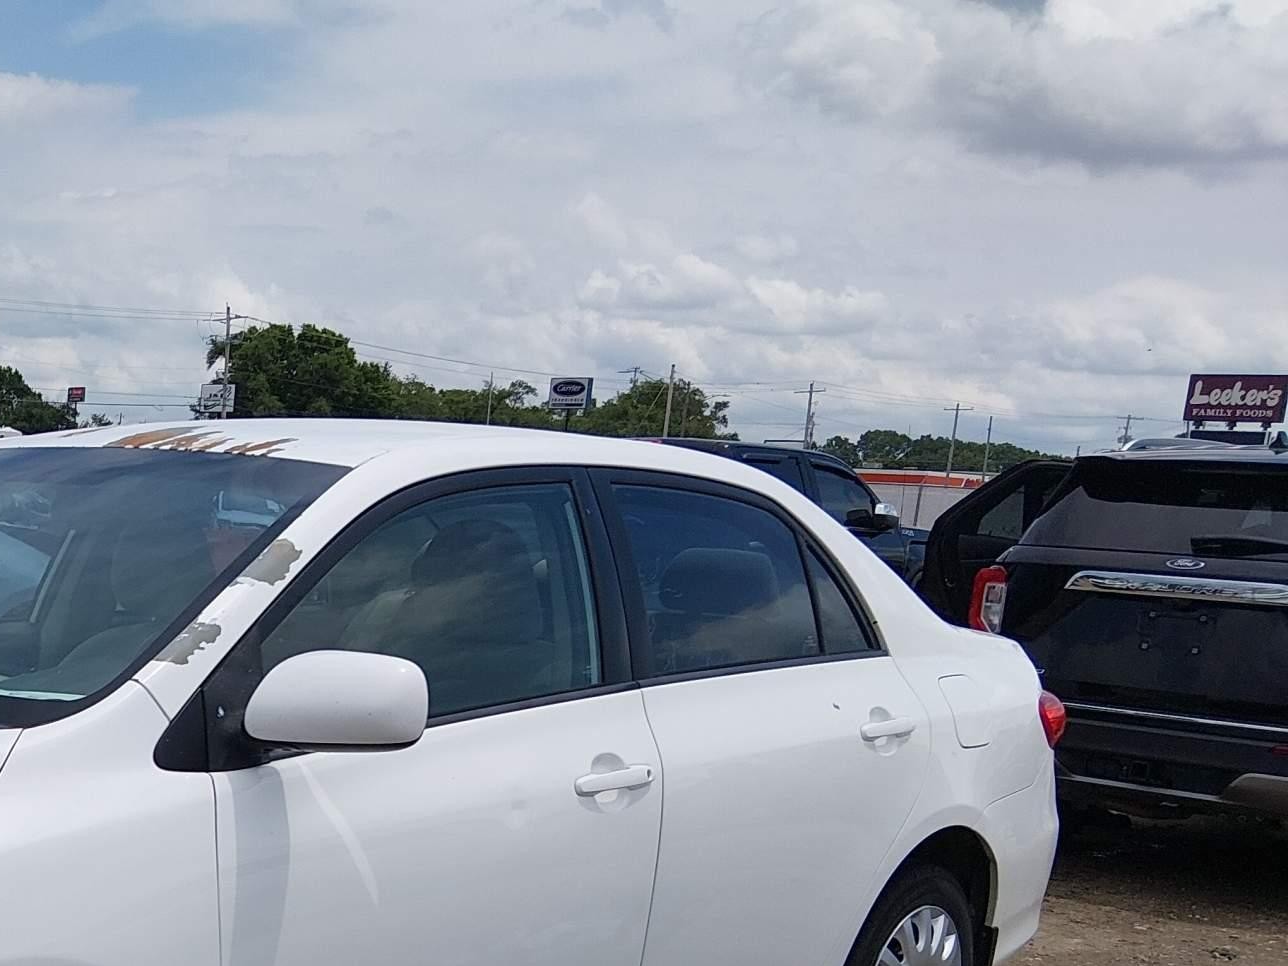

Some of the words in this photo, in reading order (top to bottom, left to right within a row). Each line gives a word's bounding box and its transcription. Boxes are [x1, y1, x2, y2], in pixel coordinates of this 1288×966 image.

[1189, 380, 1283, 407] Leeker's
[1191, 408, 1233, 417] FAMILY
[1235, 409, 1274, 418] FOODS
